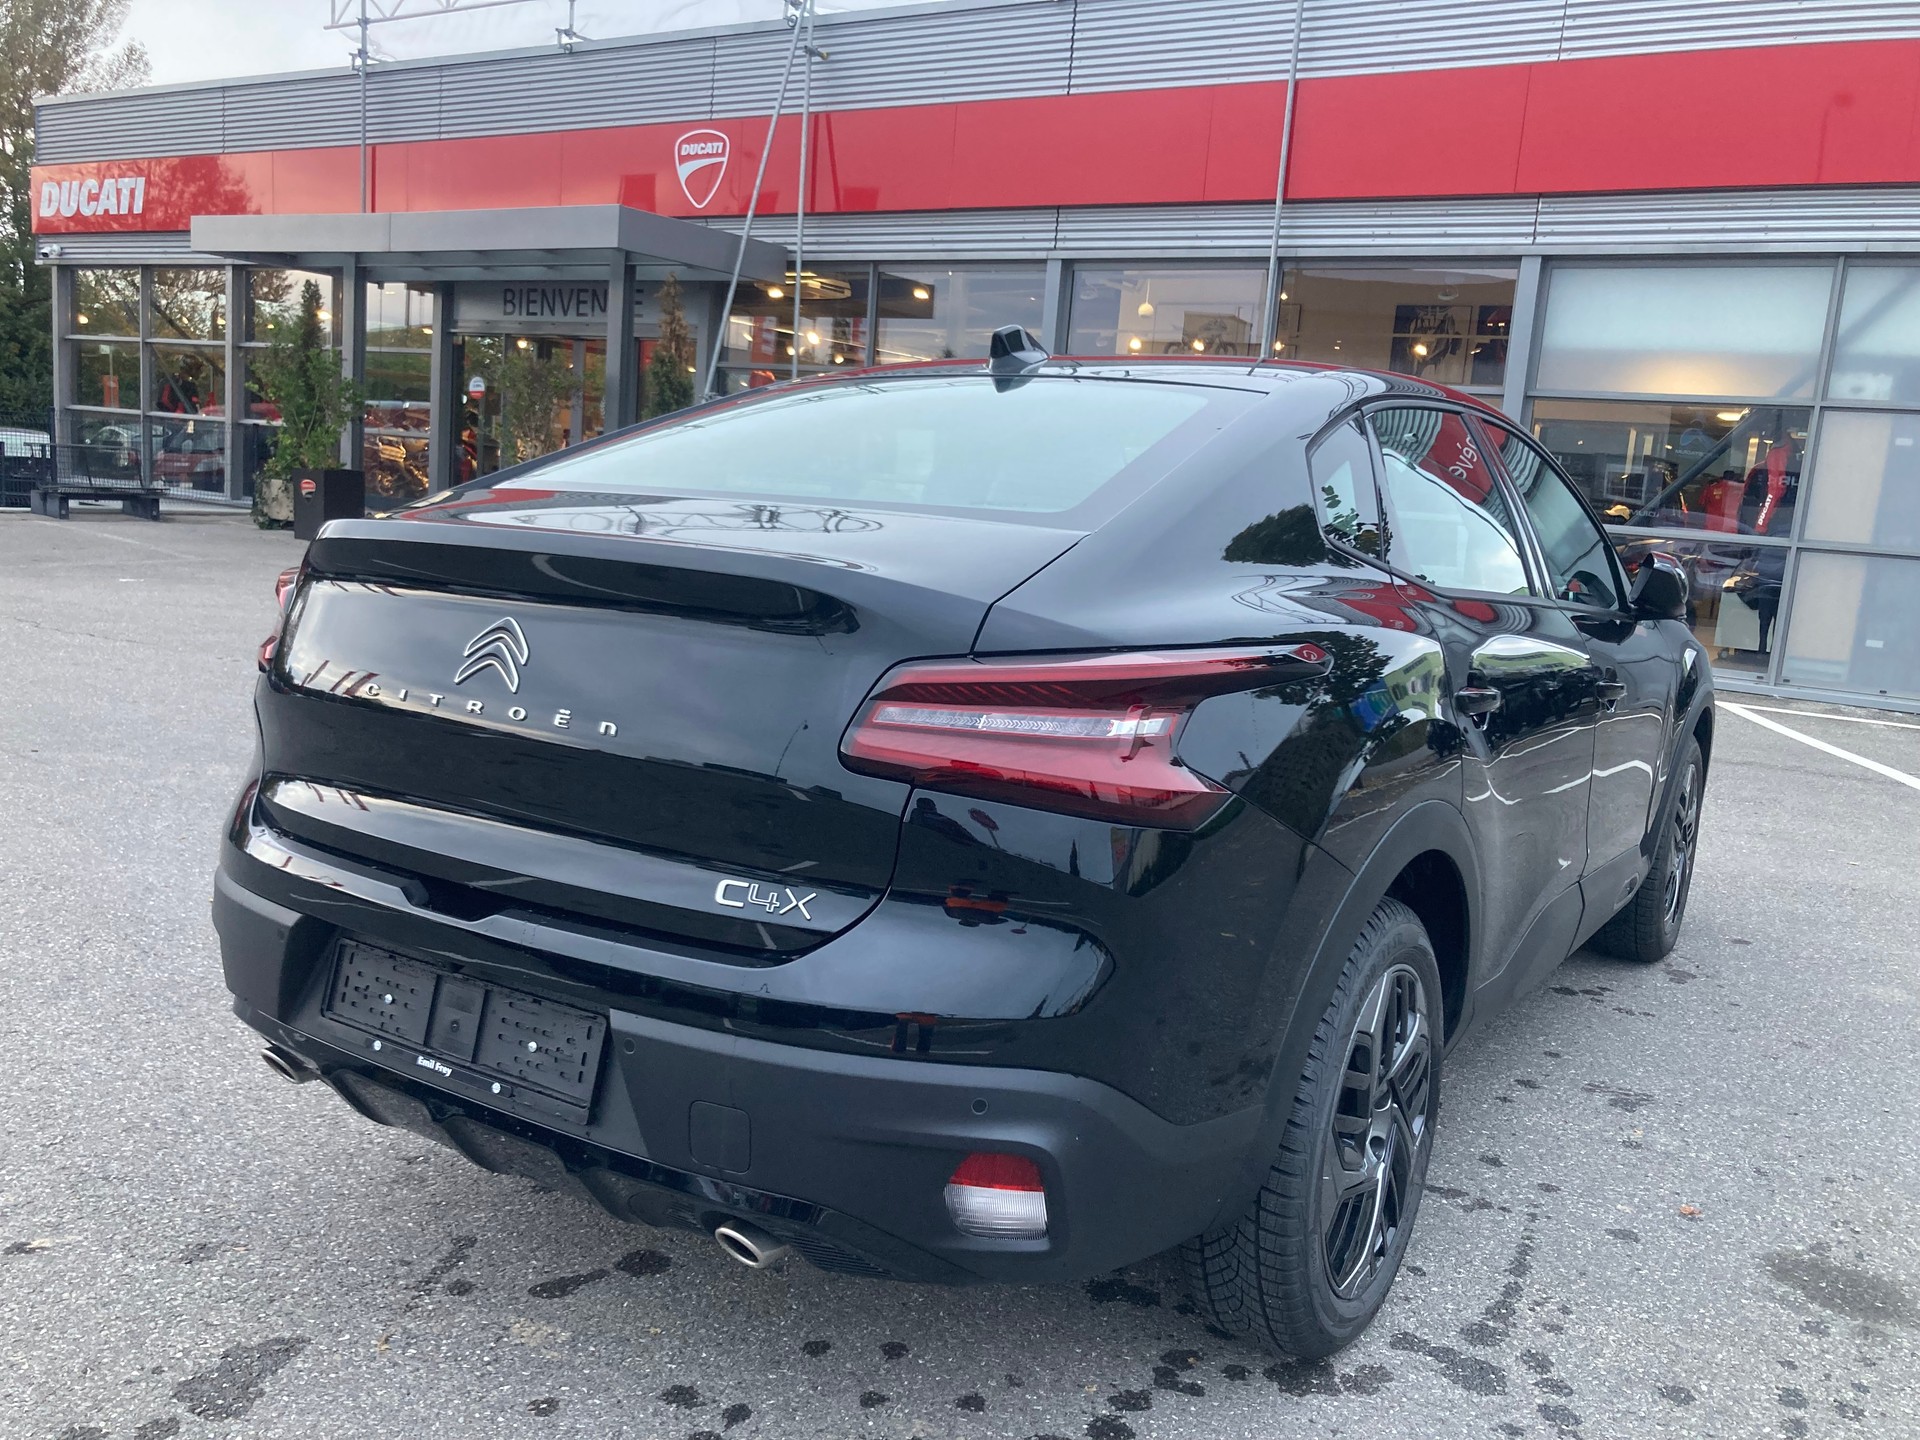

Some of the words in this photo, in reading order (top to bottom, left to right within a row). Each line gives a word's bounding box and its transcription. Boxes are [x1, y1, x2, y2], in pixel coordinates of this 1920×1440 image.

[680, 142, 724, 156] DUCATI
[39, 176, 146, 217] DUCATI
[503, 287, 643, 318] BIENVENE
[1757, 493, 1773, 526] DUCATI
[416, 1055, 436, 1070] Emil
[434, 1062, 453, 1077] Frey
